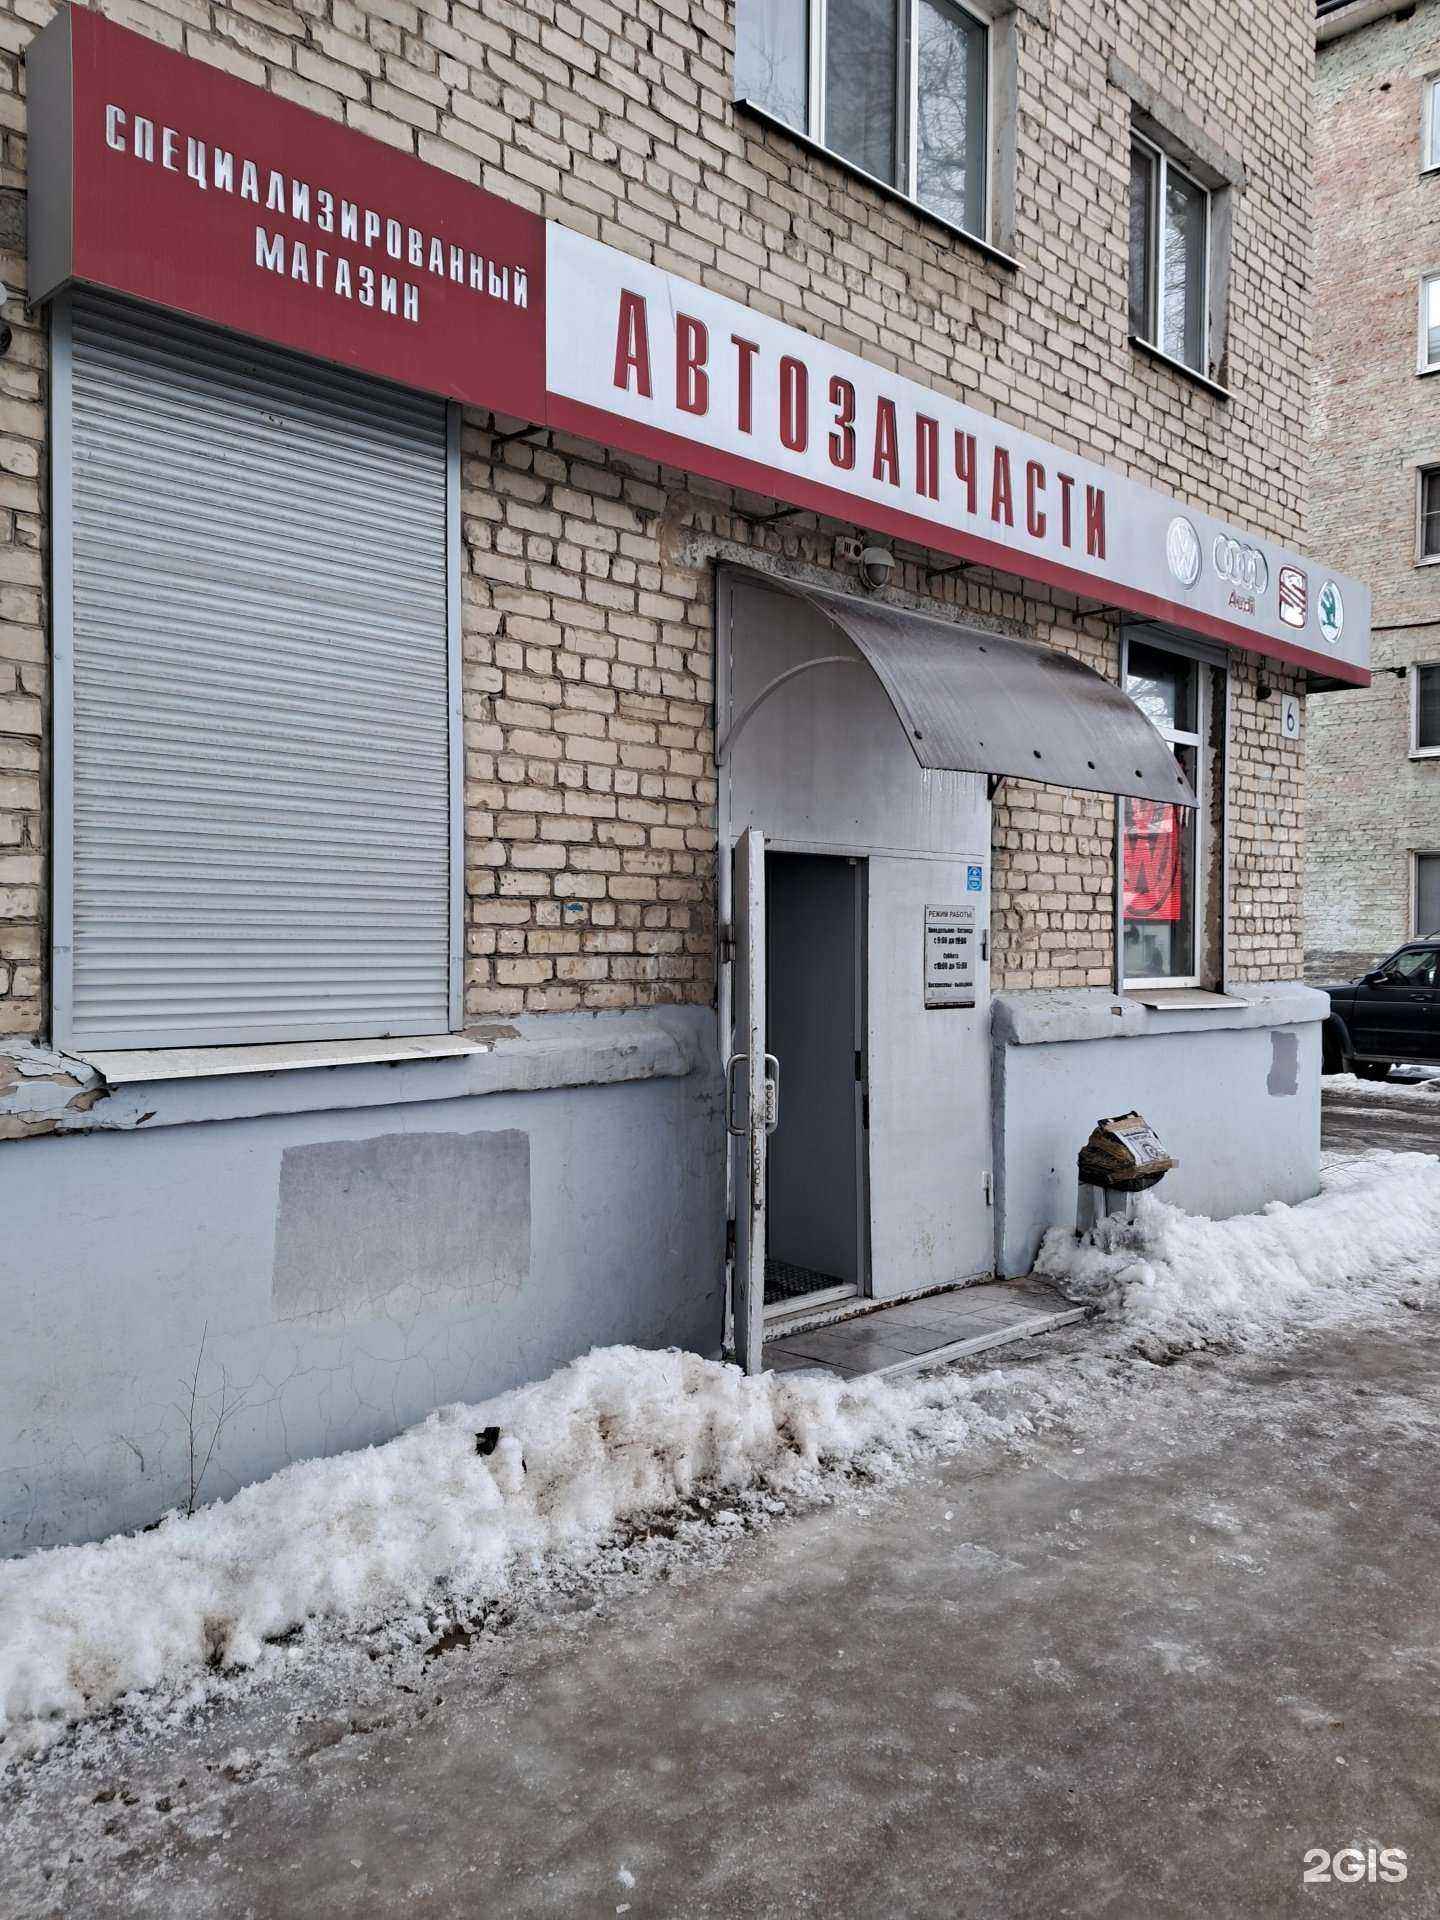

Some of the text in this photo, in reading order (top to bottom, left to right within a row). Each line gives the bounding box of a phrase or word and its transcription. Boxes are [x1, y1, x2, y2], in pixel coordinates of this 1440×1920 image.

[105, 103, 529, 310] СПЕЦИАЛИЗИРОВАННЫЙ
[255, 226, 420, 323] МАГАЗИН
[613, 287, 1107, 561] АВТОЗАПЧАСТИ
[1228, 590, 1256, 616] Audi
[1286, 702, 1295, 732] 6
[928, 910, 948, 918] РЕЖИМ
